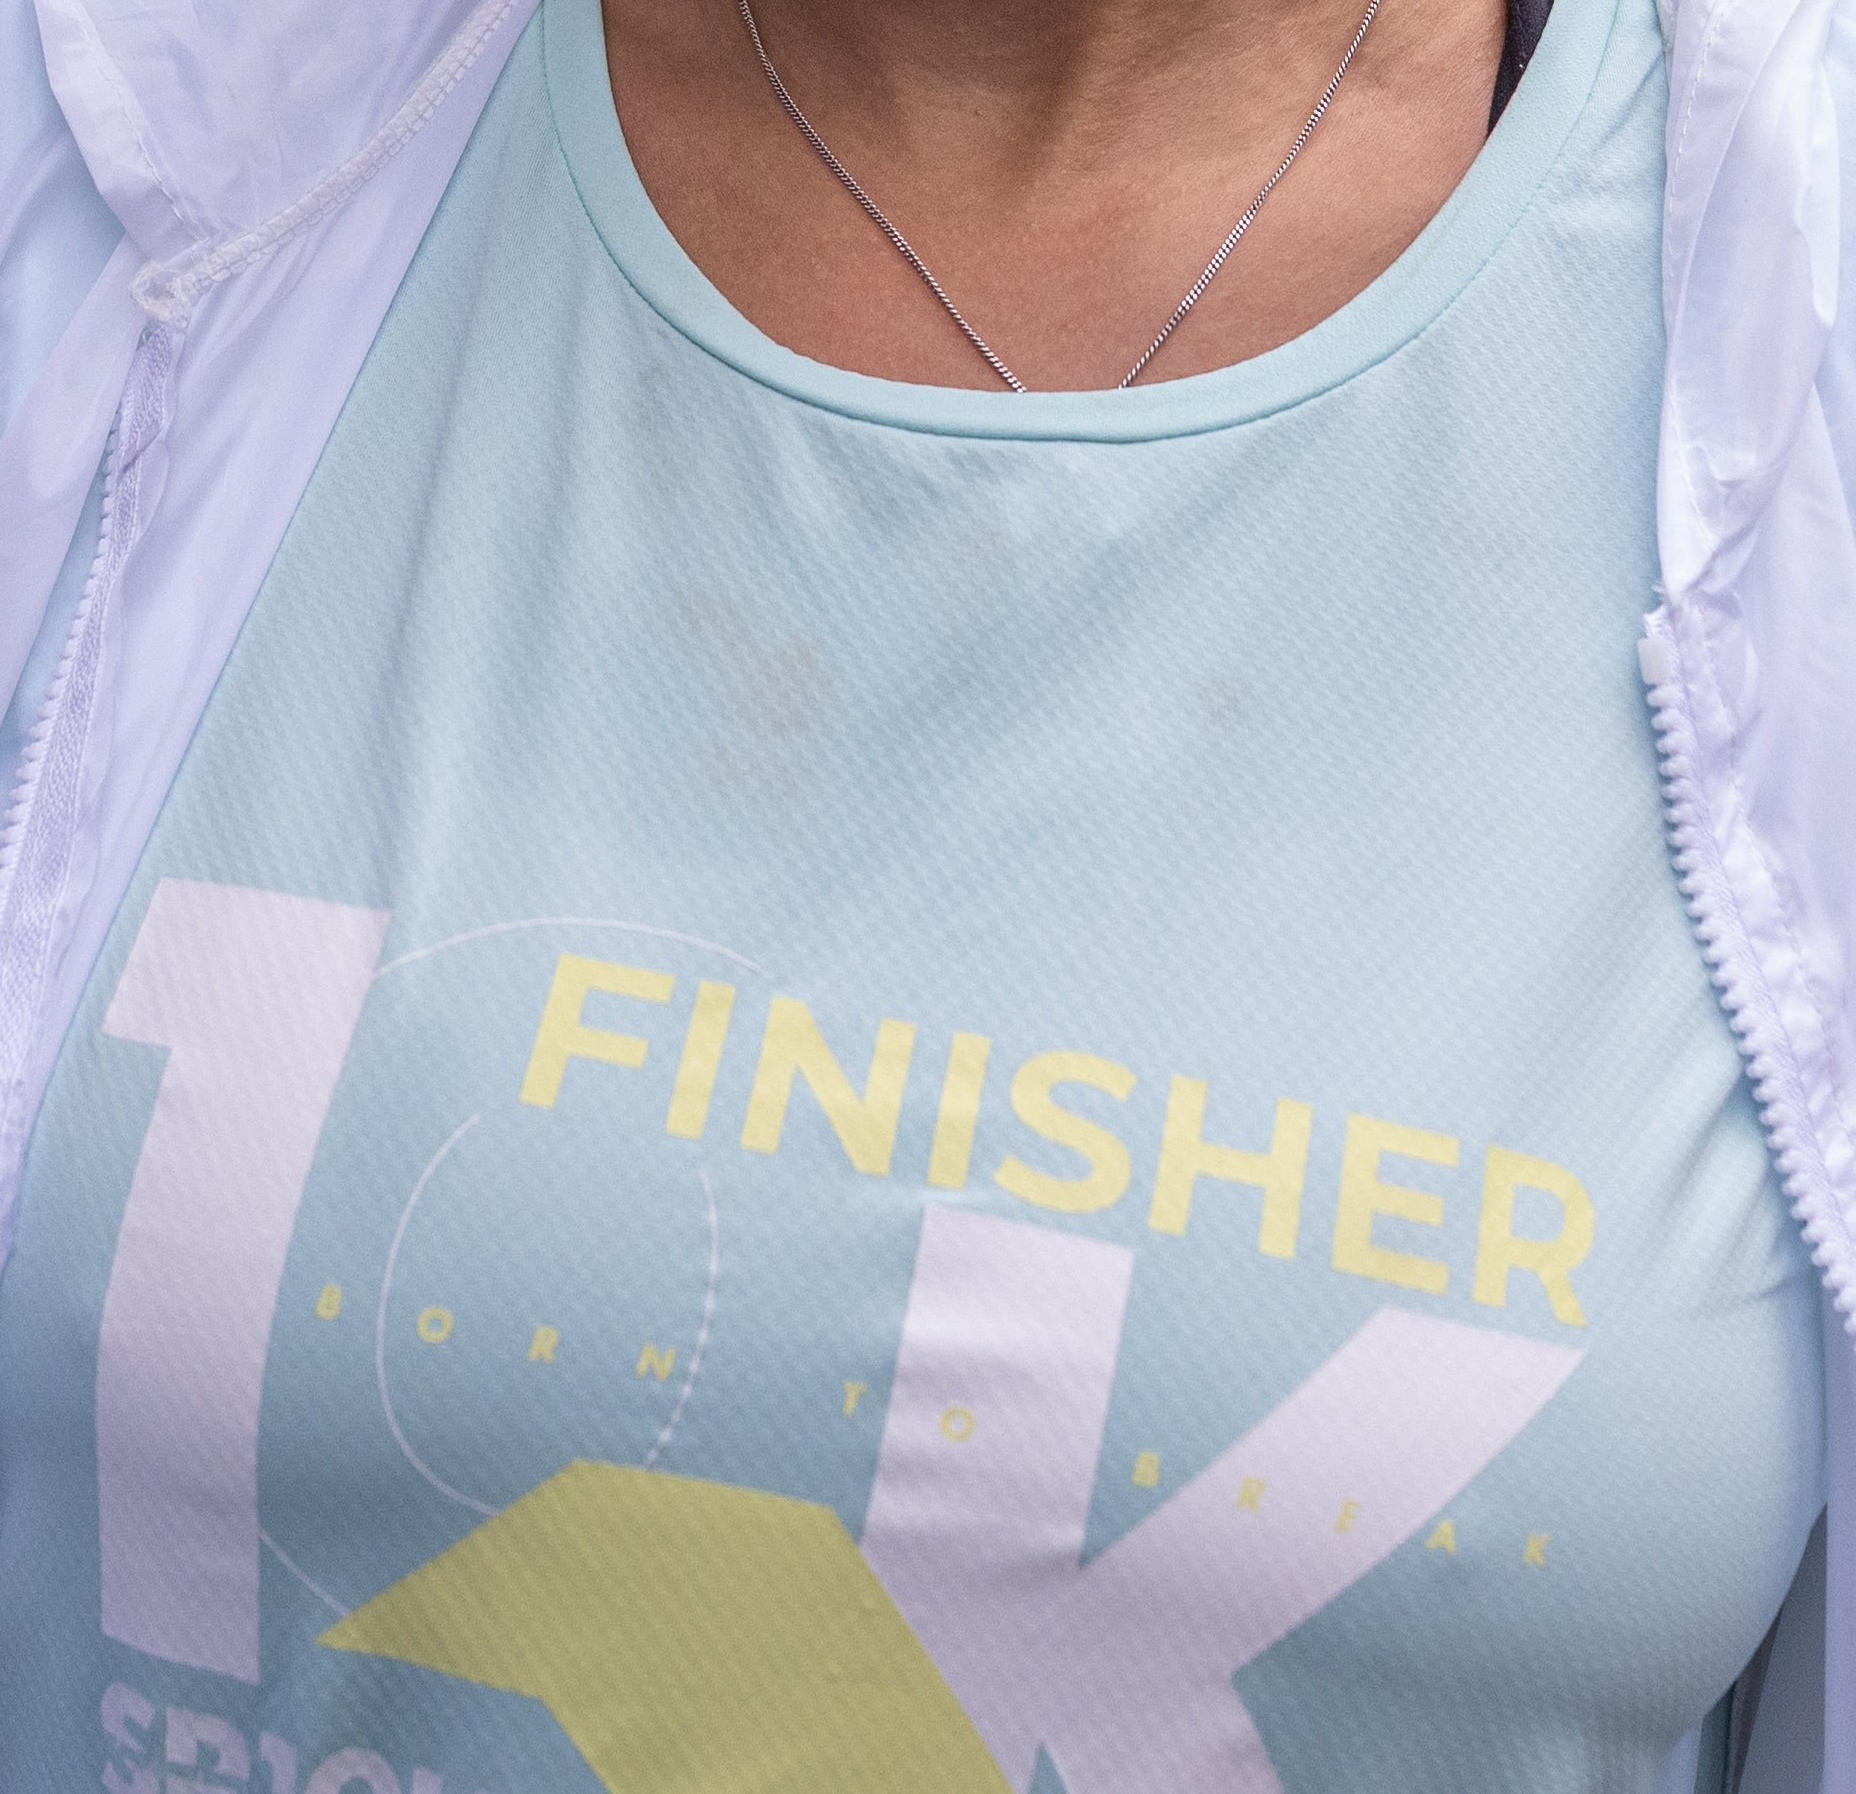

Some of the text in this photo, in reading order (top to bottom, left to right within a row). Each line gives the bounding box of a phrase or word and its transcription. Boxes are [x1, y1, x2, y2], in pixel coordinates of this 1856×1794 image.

[518, 951, 1597, 1329] FINISHER
[314, 1282, 1552, 1570] BORN TO BREAK
